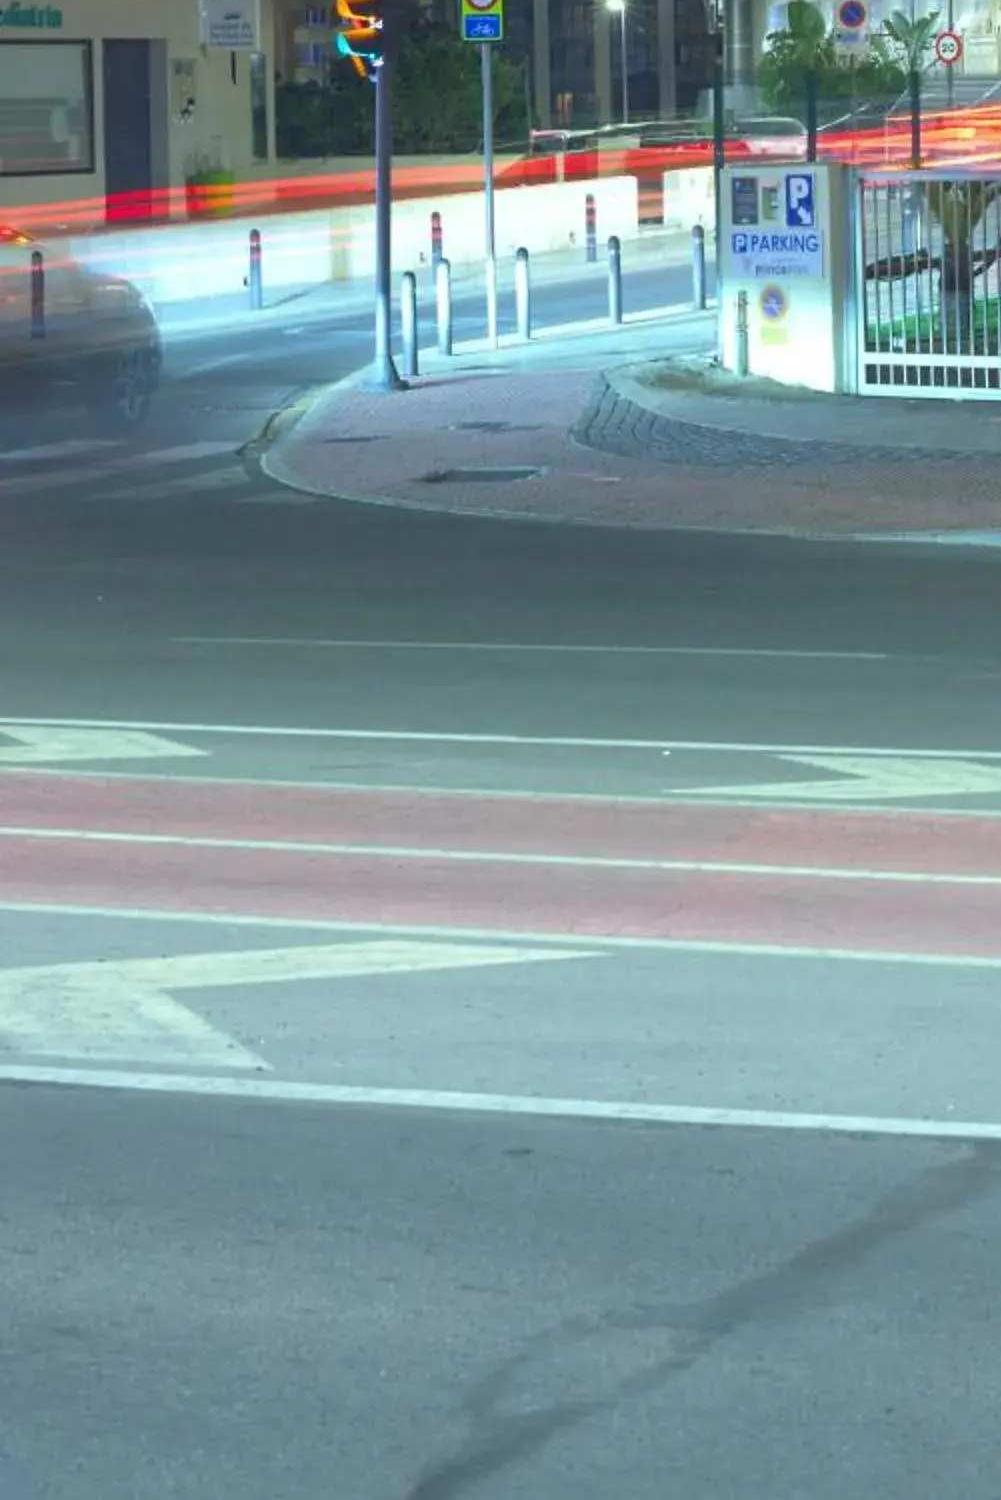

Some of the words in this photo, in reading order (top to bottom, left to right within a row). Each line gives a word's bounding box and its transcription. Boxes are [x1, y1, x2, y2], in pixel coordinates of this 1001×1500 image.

[941, 43, 955, 53] 20
[790, 177, 809, 209] P
[751, 234, 819, 252] PARKING
